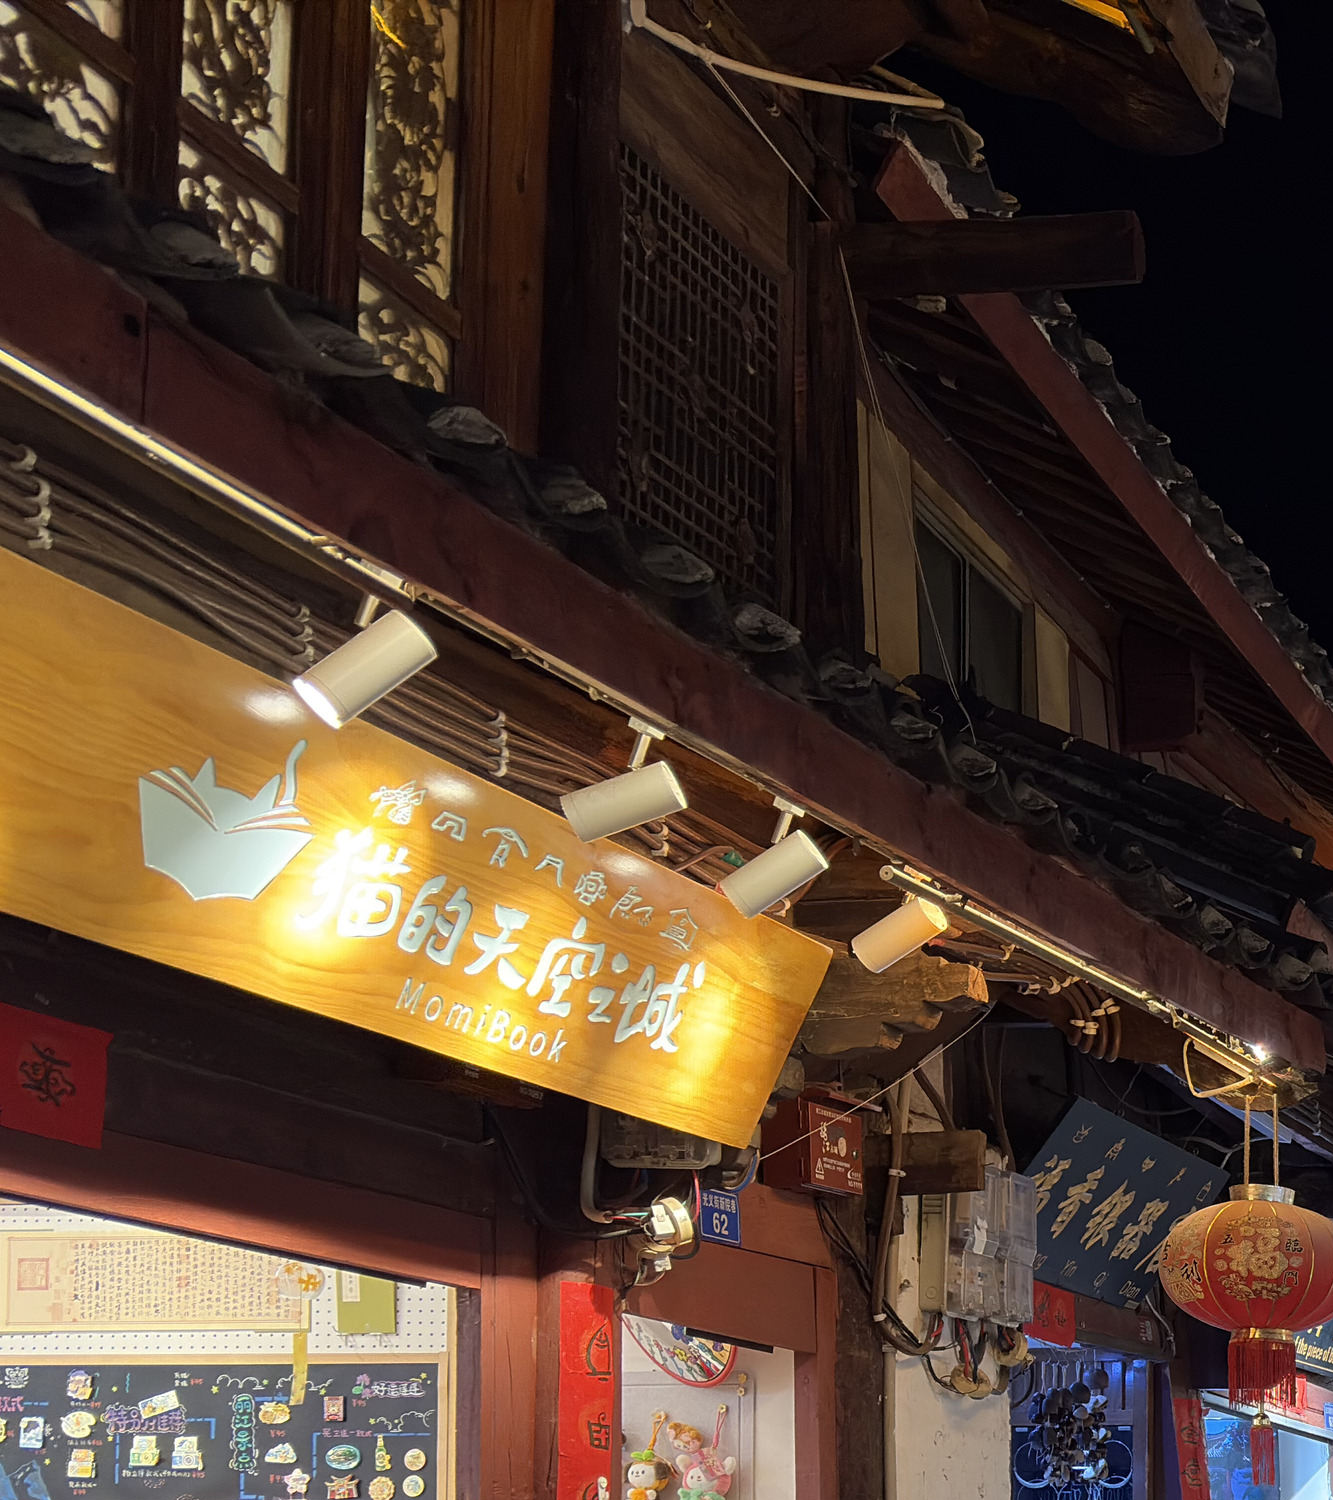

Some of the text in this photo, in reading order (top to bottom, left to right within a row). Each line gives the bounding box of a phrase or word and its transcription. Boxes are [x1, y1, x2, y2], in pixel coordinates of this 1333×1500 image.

[298, 826, 706, 1053] 猫的天空之城
[395, 977, 568, 1064] MomiBook
[713, 1212, 729, 1235] 62
[1060, 1259, 1077, 1278] Yin
[1118, 1280, 1142, 1299] Dian
[1306, 1342, 1323, 1362] piece
